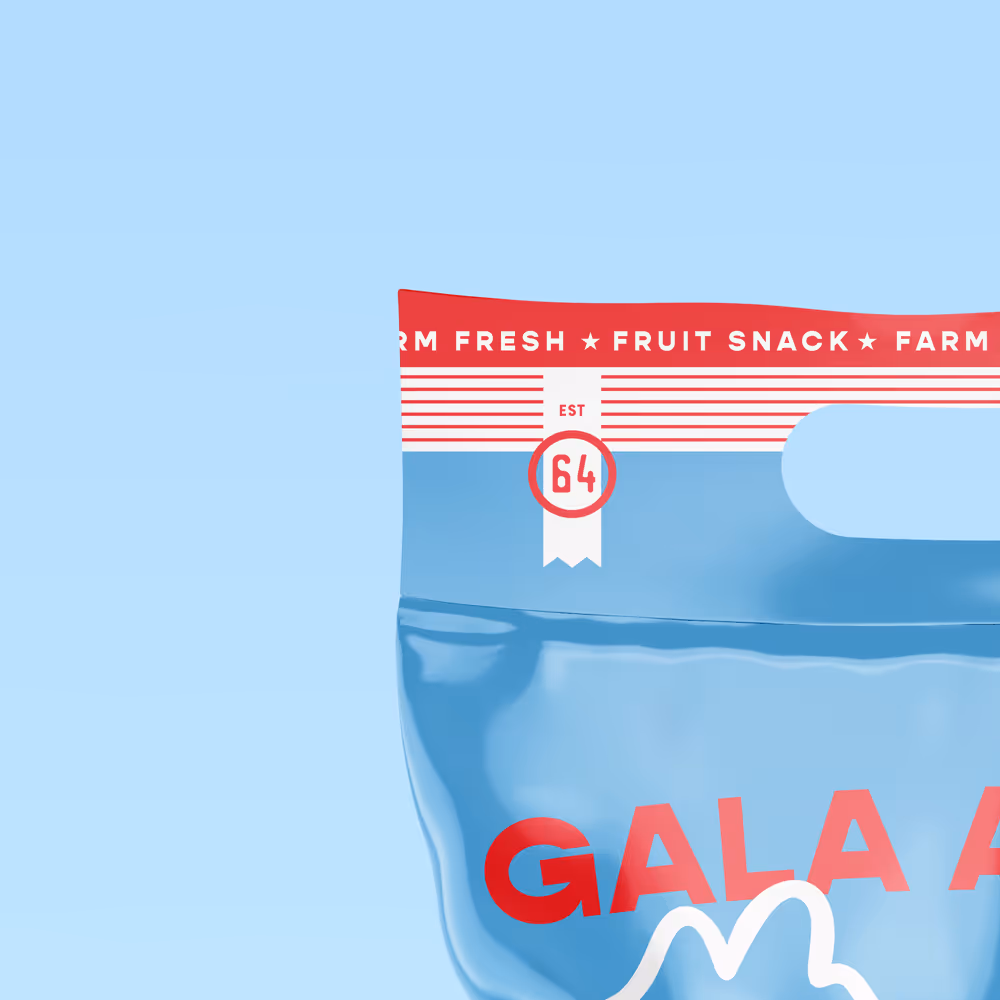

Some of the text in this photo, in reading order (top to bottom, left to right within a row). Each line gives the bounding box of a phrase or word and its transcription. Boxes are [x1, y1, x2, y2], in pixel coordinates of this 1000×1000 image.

[455, 330, 564, 352] FRESH
[613, 330, 712, 352] FRUIT
[728, 330, 849, 352] SNACK
[896, 330, 988, 352] FARM
[558, 403, 586, 417] EST
[551, 453, 597, 494] 64
[484, 789, 910, 925] GALA
